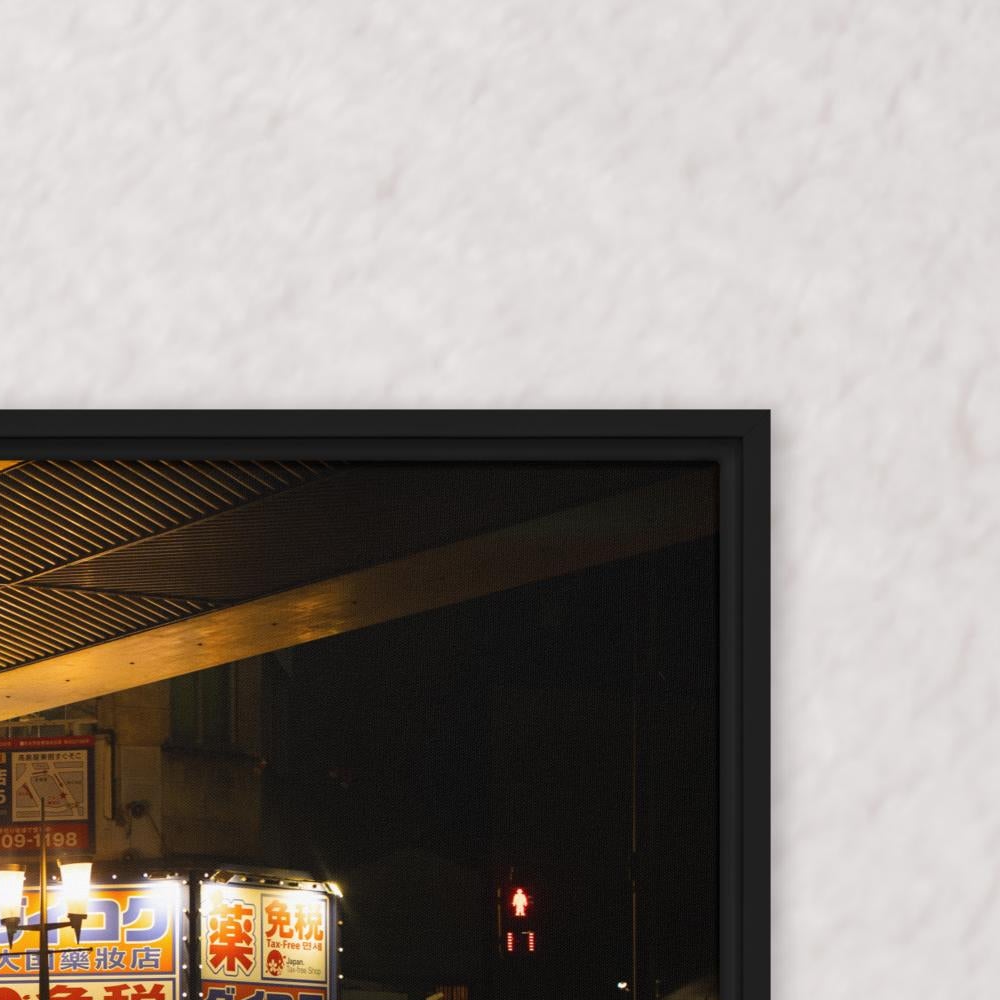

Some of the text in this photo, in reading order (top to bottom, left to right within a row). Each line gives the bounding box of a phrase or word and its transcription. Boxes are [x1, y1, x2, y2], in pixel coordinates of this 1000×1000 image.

[209, 903, 254, 972] 薬
[264, 901, 324, 941] 免税
[266, 939, 301, 950] Tax-Free
